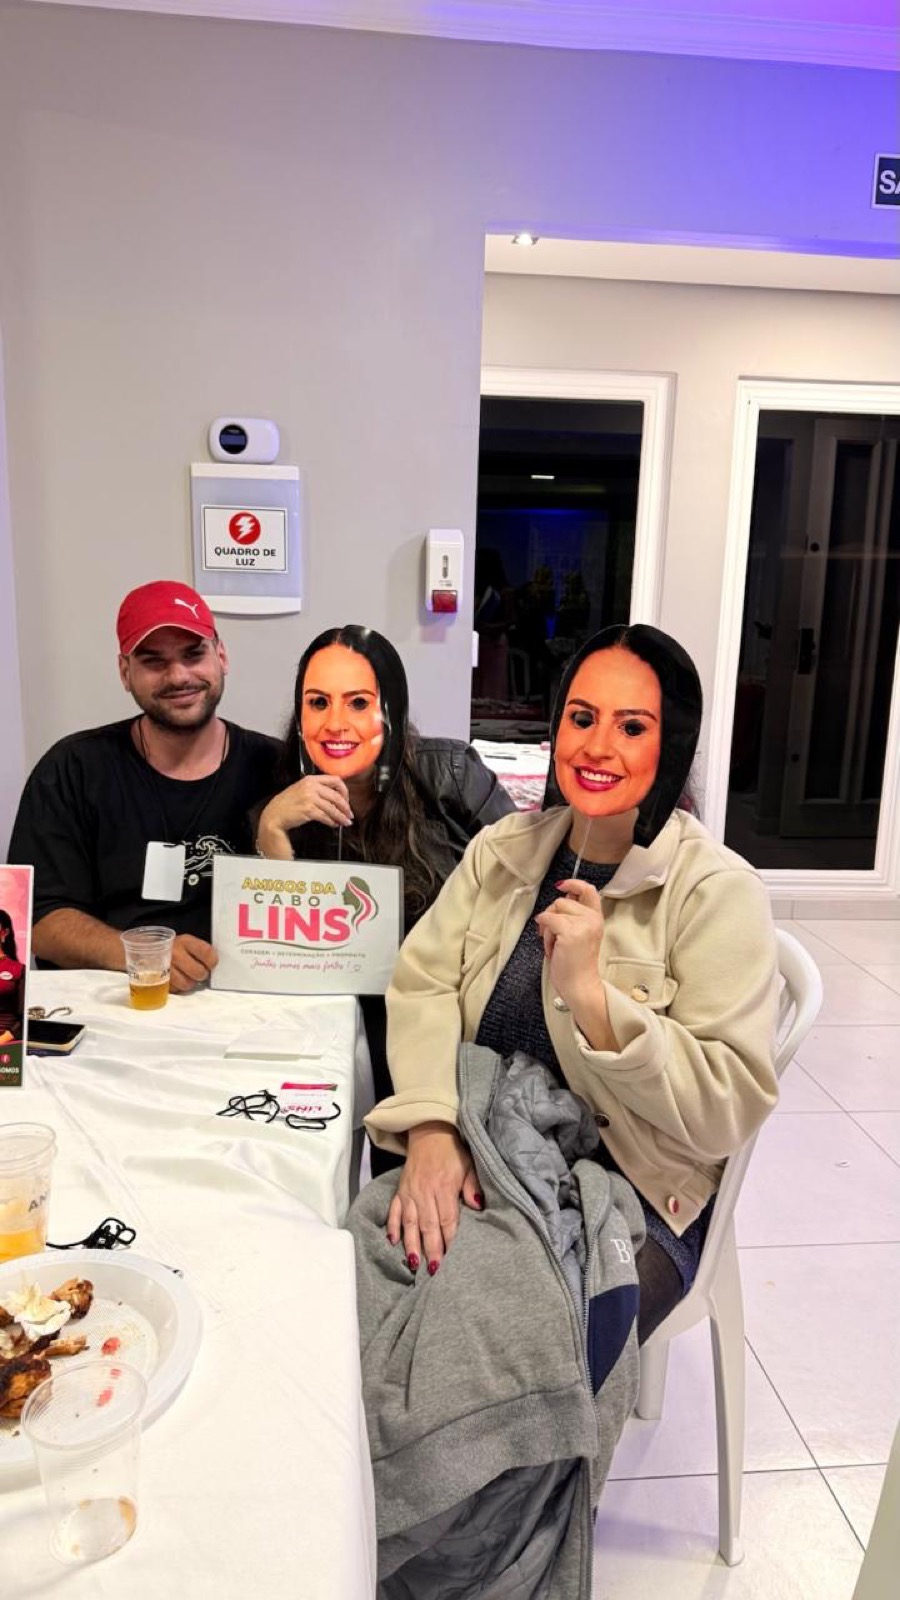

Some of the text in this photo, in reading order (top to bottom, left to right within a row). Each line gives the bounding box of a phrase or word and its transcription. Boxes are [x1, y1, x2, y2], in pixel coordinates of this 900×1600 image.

[214, 546, 277, 557] QUADRO DE
[235, 558, 256, 566] LUZ
[241, 877, 337, 895] AMIGOS DA
[253, 892, 321, 907] CABO
[238, 903, 351, 942] LINS
[240, 948, 271, 956] CORAGEM
